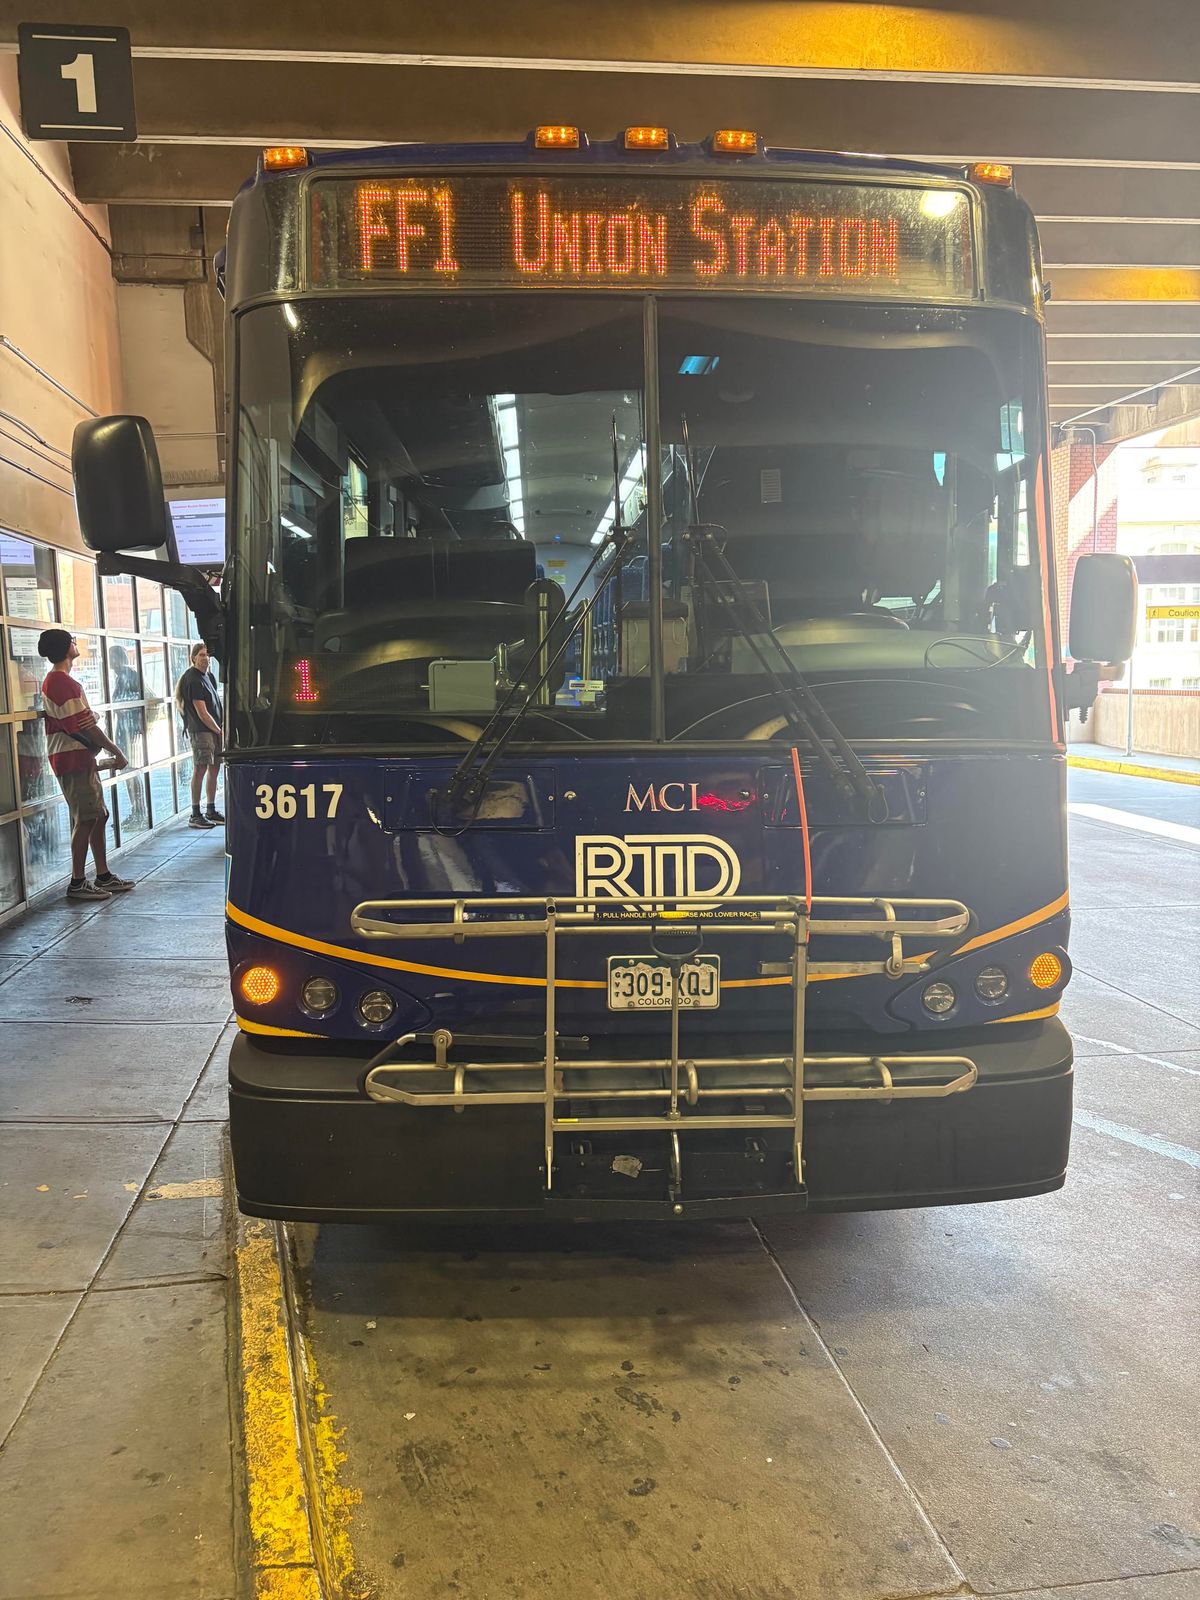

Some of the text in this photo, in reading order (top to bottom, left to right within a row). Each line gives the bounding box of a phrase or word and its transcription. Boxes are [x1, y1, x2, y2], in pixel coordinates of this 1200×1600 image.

[60, 53, 97, 113] 1
[359, 189, 459, 272] FF1
[1168, 609, 1200, 617] Caution
[292, 659, 319, 701] 1
[254, 782, 344, 820] 3617
[623, 783, 701, 813] MCI
[575, 834, 741, 912] RTD
[637, 998, 692, 1006] COLORDO
